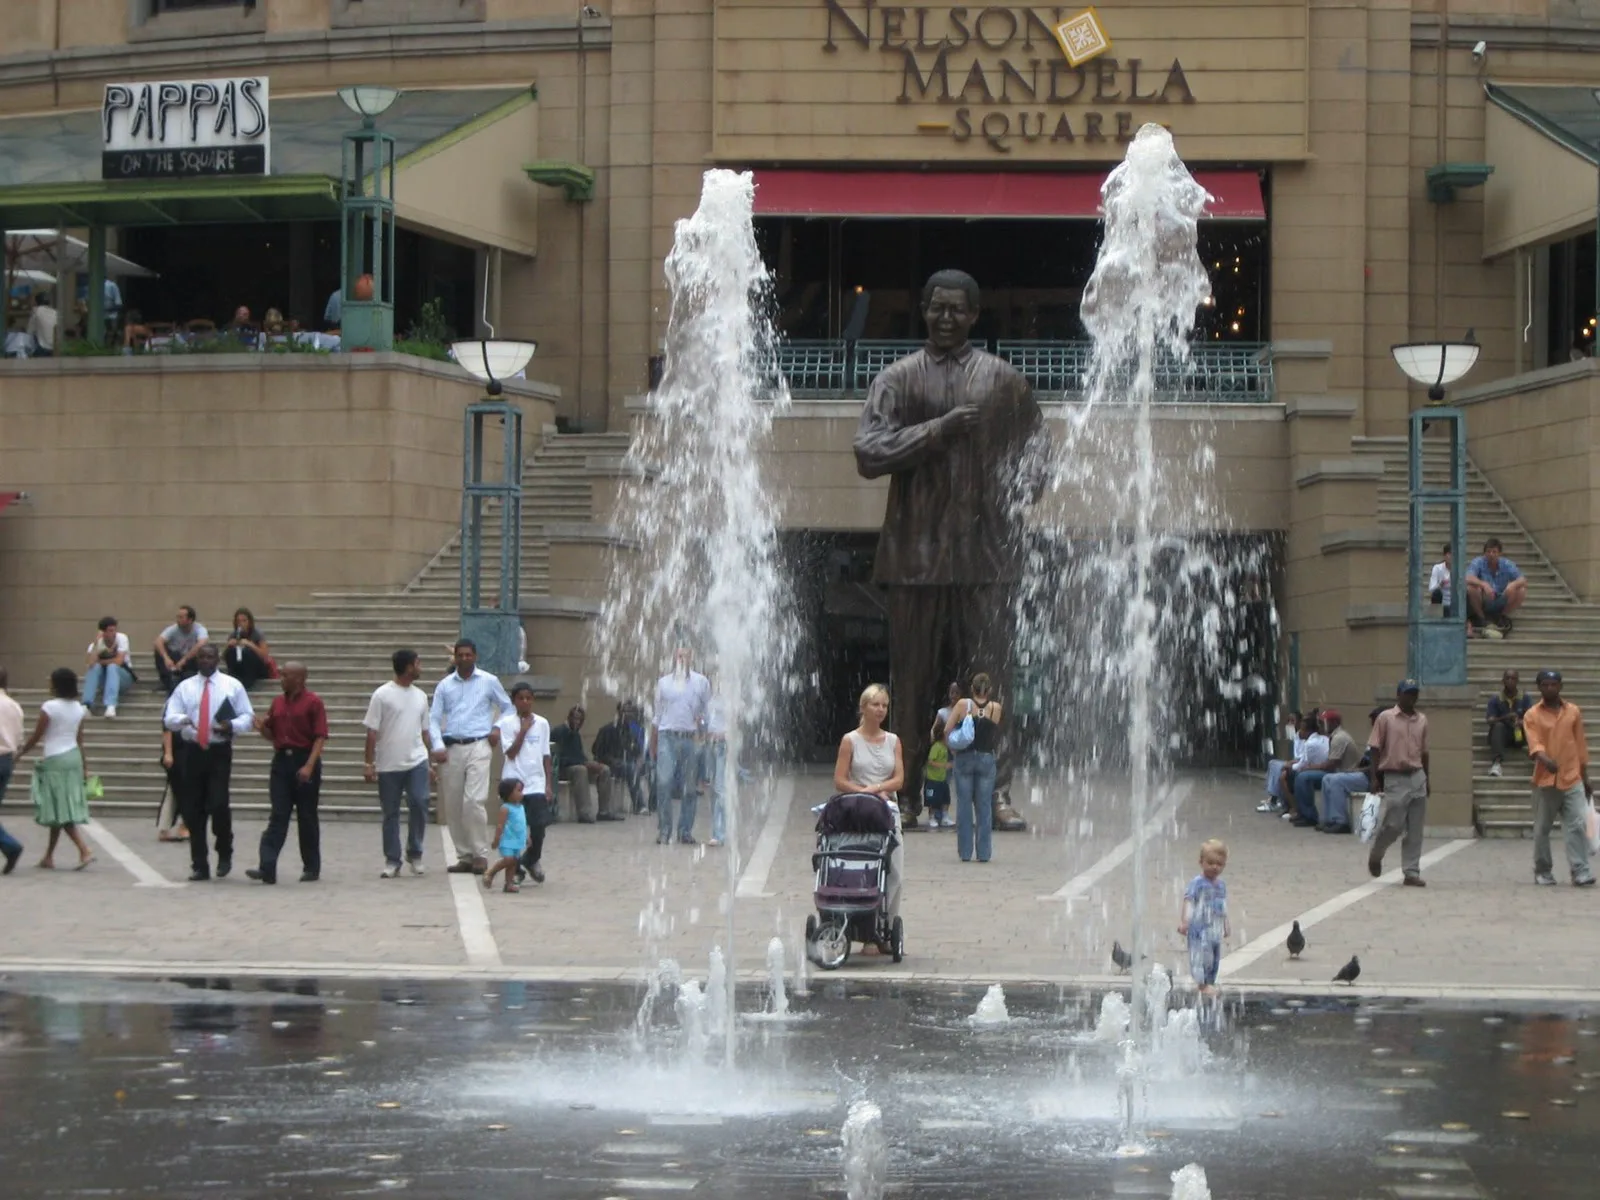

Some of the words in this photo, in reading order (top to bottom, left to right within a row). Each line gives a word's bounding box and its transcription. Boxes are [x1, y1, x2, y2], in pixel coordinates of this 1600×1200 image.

[821, 0, 1064, 52] NELSON
[895, 45, 1197, 105] MANDELA
[104, 78, 266, 143] PAPPAS
[953, 107, 1136, 152] SQUARE
[120, 153, 142, 174] ON
[146, 151, 174, 172] THE
[179, 149, 236, 172] SQUARE
